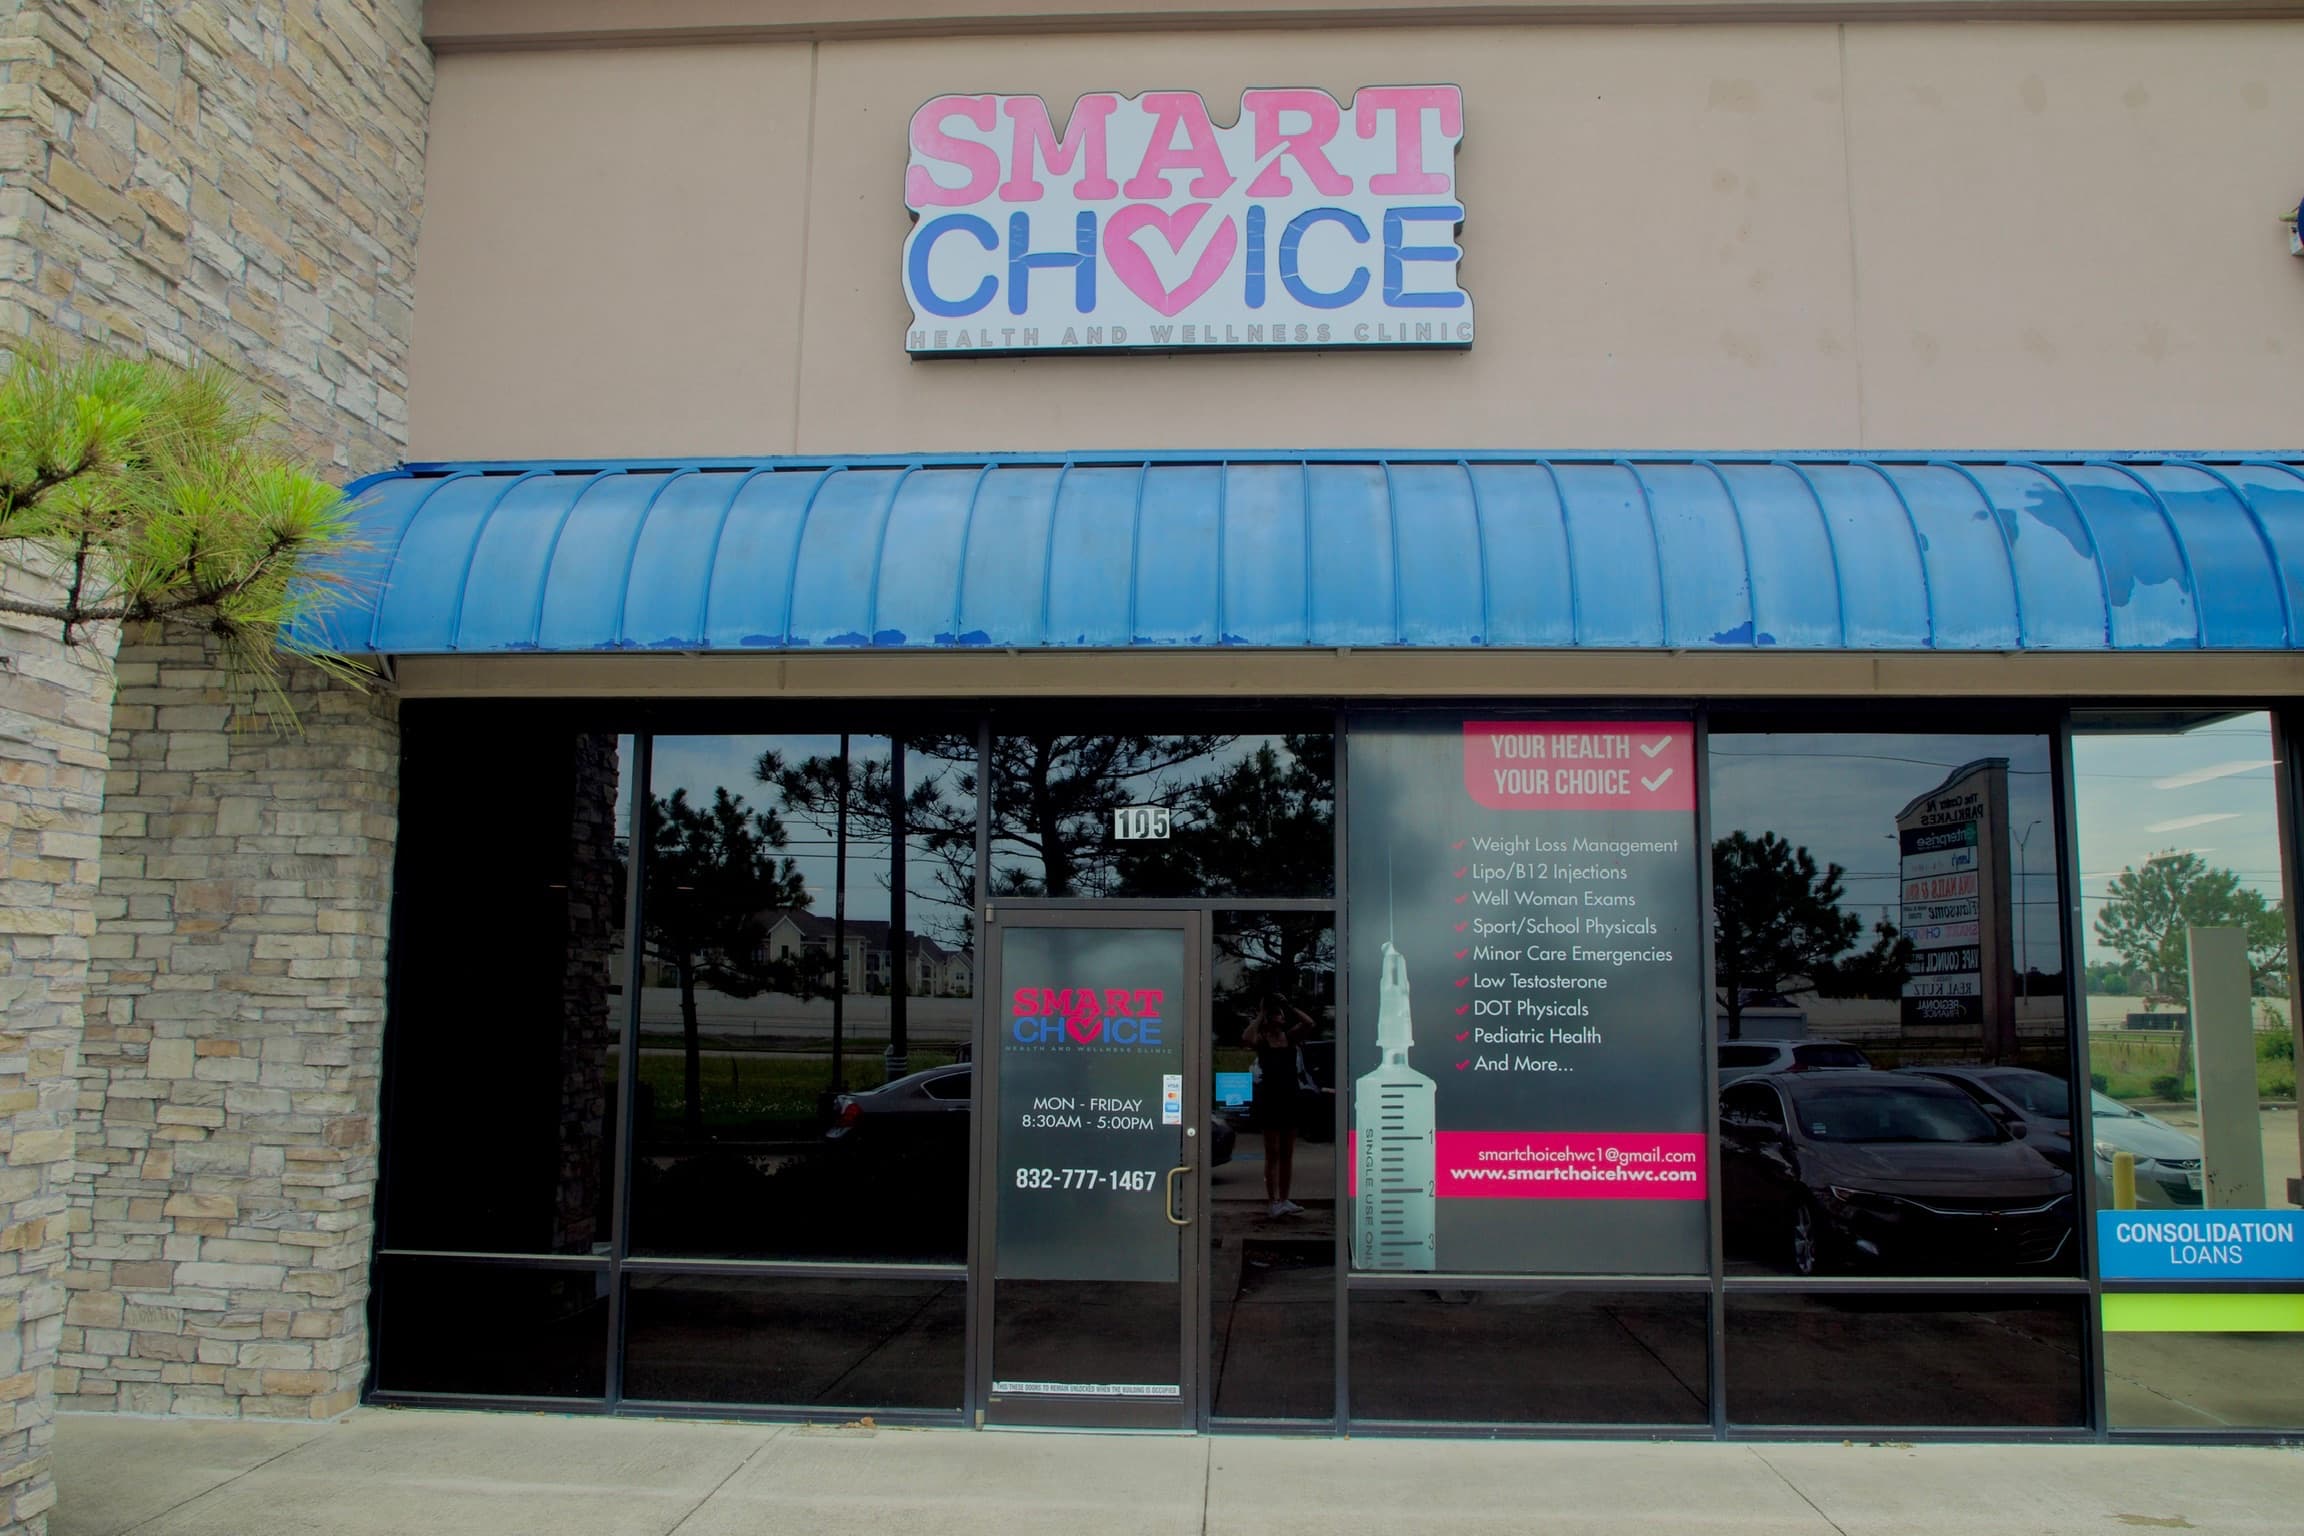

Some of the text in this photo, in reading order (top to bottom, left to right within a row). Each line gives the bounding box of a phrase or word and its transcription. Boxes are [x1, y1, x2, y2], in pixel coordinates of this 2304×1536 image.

[905, 87, 1461, 207] SMART
[908, 203, 1465, 318] CHOICE
[910, 321, 1473, 349] HEALTH AND WELLNESS CLINIC
[1490, 734, 1630, 759] YOUR HEALTH
[1494, 769, 1631, 794] YOUR CHOICE
[1119, 810, 1168, 838] 105
[1472, 836, 1678, 857] Weight Loss Management
[1472, 863, 1628, 884] Lipo/B12 Injections
[1472, 890, 1636, 907] Well Woman Exams
[1472, 918, 1657, 939] Sport/School Physicals
[1472, 945, 1673, 966] Minor Care Emergencies
[1474, 973, 1608, 989] Low Testosterone
[1013, 988, 1164, 1017] SMART
[1474, 1000, 1589, 1020] DOT Physicals
[1474, 1028, 1602, 1044] Pediatric Health
[1474, 1055, 1574, 1072] And More...
[1033, 1098, 1074, 1111] MON
[1090, 1099, 1143, 1112] FRIDAY
[1022, 1115, 1081, 1128] 8:30AM
[1096, 1116, 1153, 1130] 5:00PM
[1428, 1130, 1433, 1144] 1
[1365, 1128, 1374, 1187] SINGLE
[1478, 1145, 1696, 1165] smartchoicehwc1@gmail.com
[1016, 1168, 1156, 1191] 832-777-1467
[1450, 1165, 1697, 1182] www.smartchoicehwc.com
[1428, 1181, 1434, 1198] 2
[1428, 1233, 1434, 1251] 3
[2116, 1223, 2293, 1243] CONSOLIDATION
[2171, 1245, 2243, 1265] LOANS
